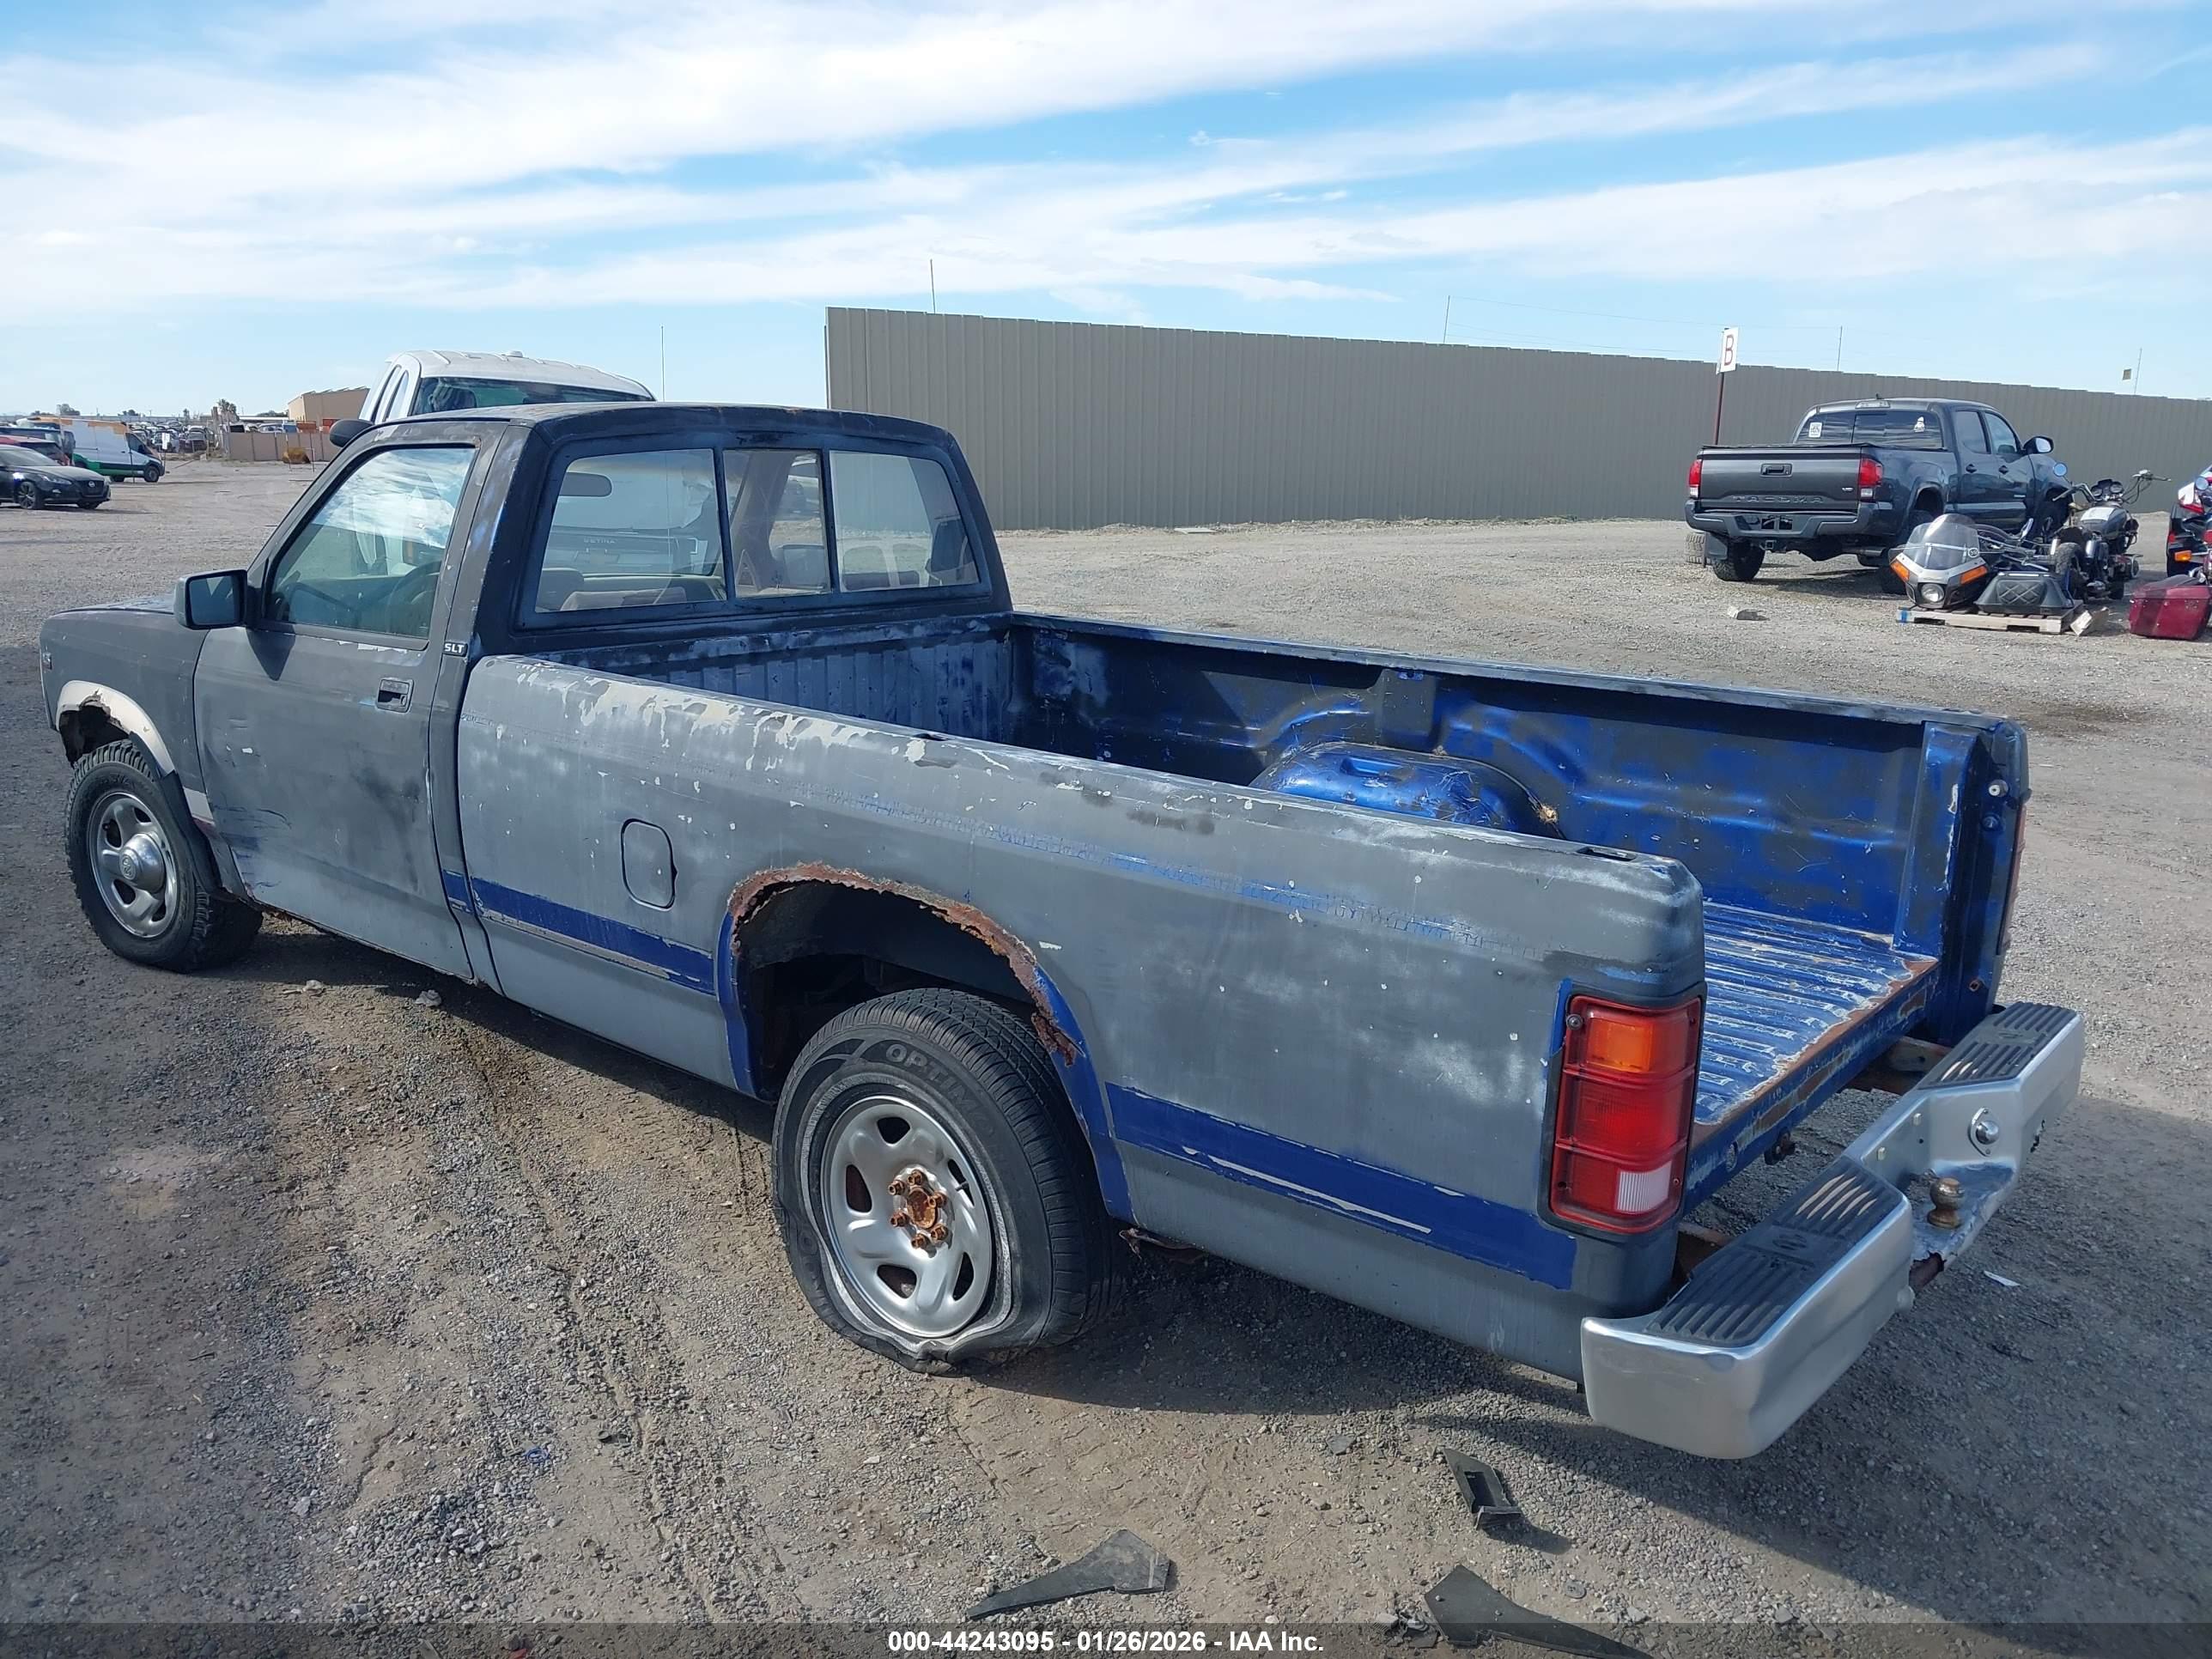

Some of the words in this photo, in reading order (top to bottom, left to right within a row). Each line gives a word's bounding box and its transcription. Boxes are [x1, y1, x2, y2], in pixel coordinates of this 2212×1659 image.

[1724, 334, 1735, 367] B
[1732, 495, 1824, 504] TACOMA
[444, 643, 465, 653] SLT
